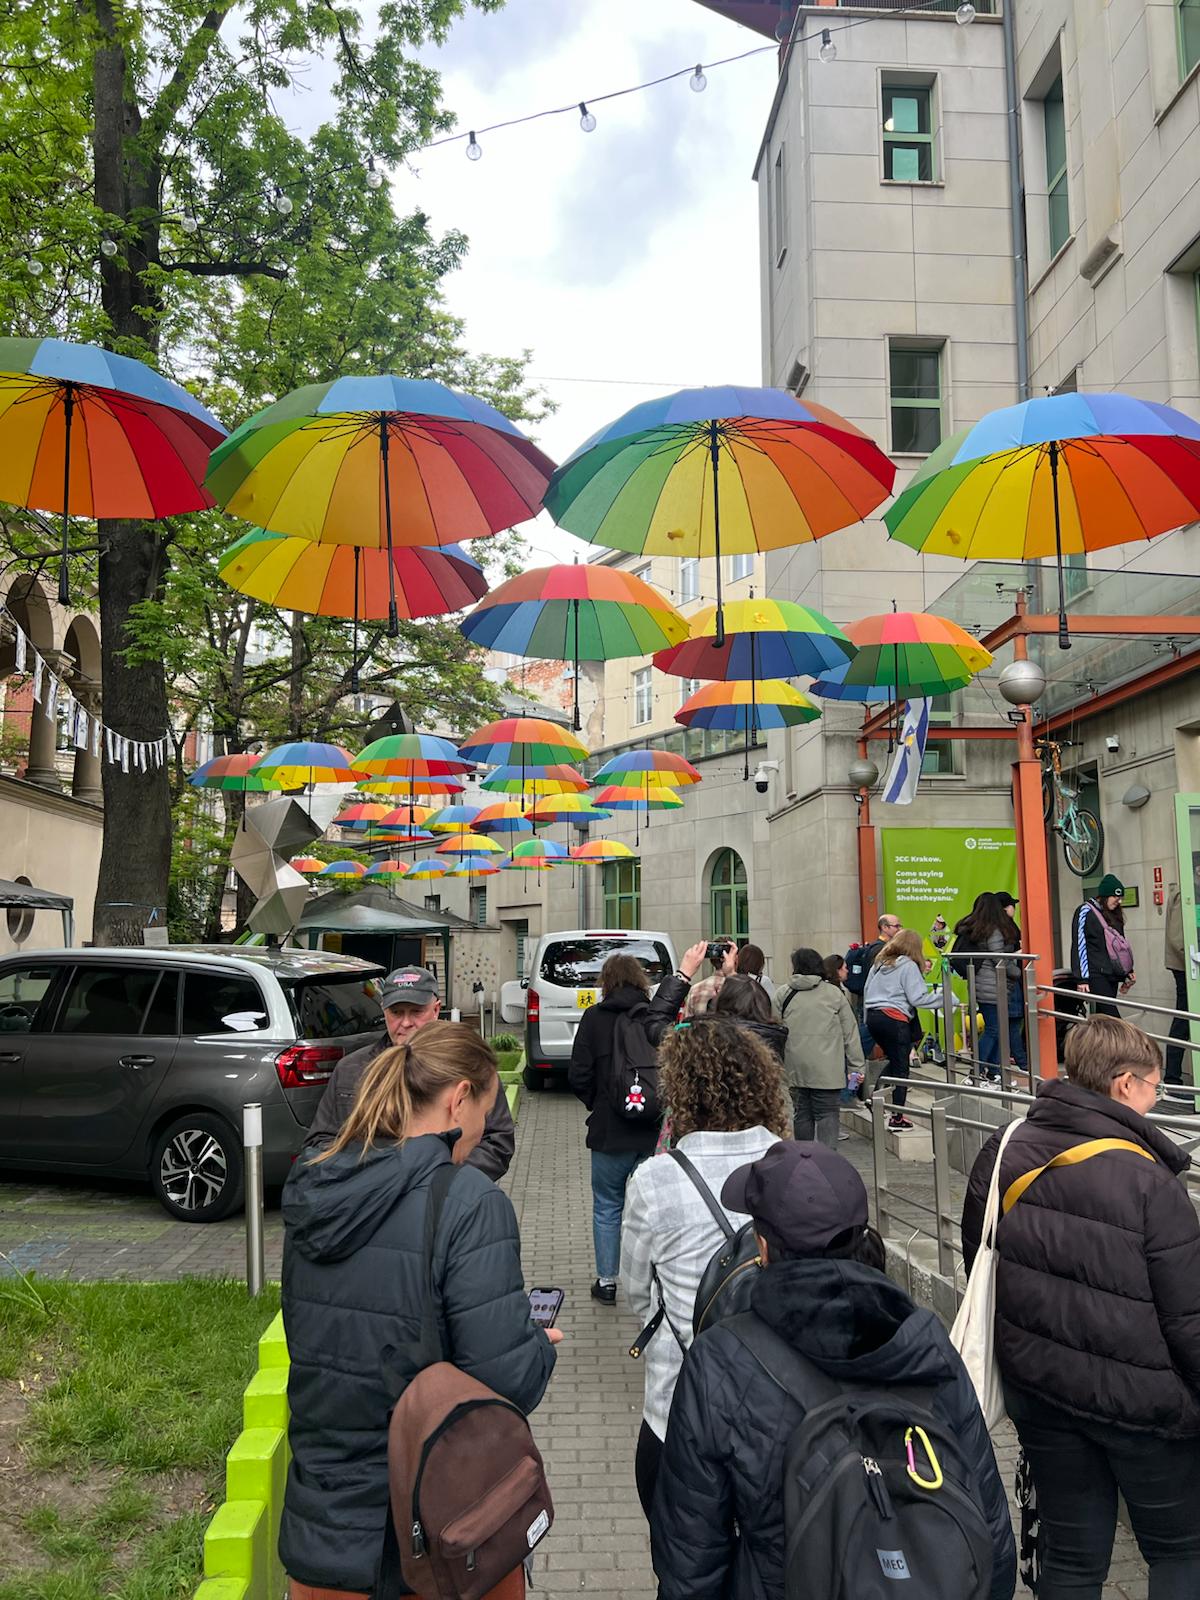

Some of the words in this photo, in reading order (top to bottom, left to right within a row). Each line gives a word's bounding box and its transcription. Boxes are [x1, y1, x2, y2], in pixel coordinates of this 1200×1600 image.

[918, 870, 944, 878] saying
[934, 886, 959, 894] saying
[882, 1558, 905, 1570] MEC
